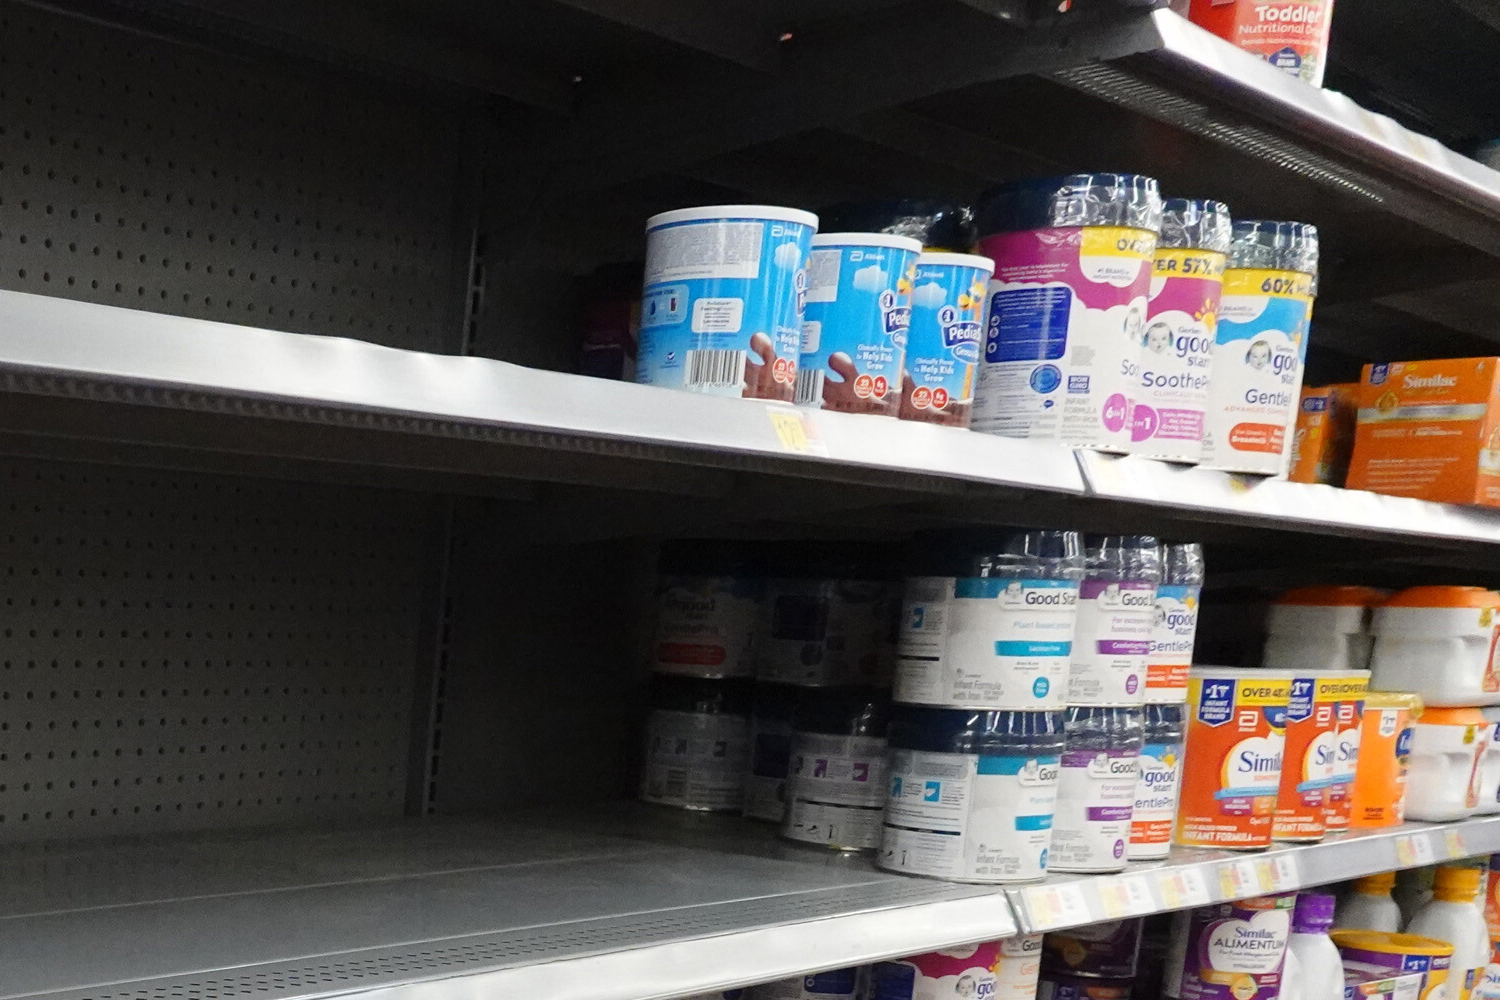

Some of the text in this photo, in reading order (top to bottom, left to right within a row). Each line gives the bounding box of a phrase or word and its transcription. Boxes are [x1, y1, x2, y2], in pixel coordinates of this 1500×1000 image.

[1255, 5, 1323, 23] Toddler
[1239, 23, 1305, 34] Nutritional
[1025, 592, 1060, 606] Good
